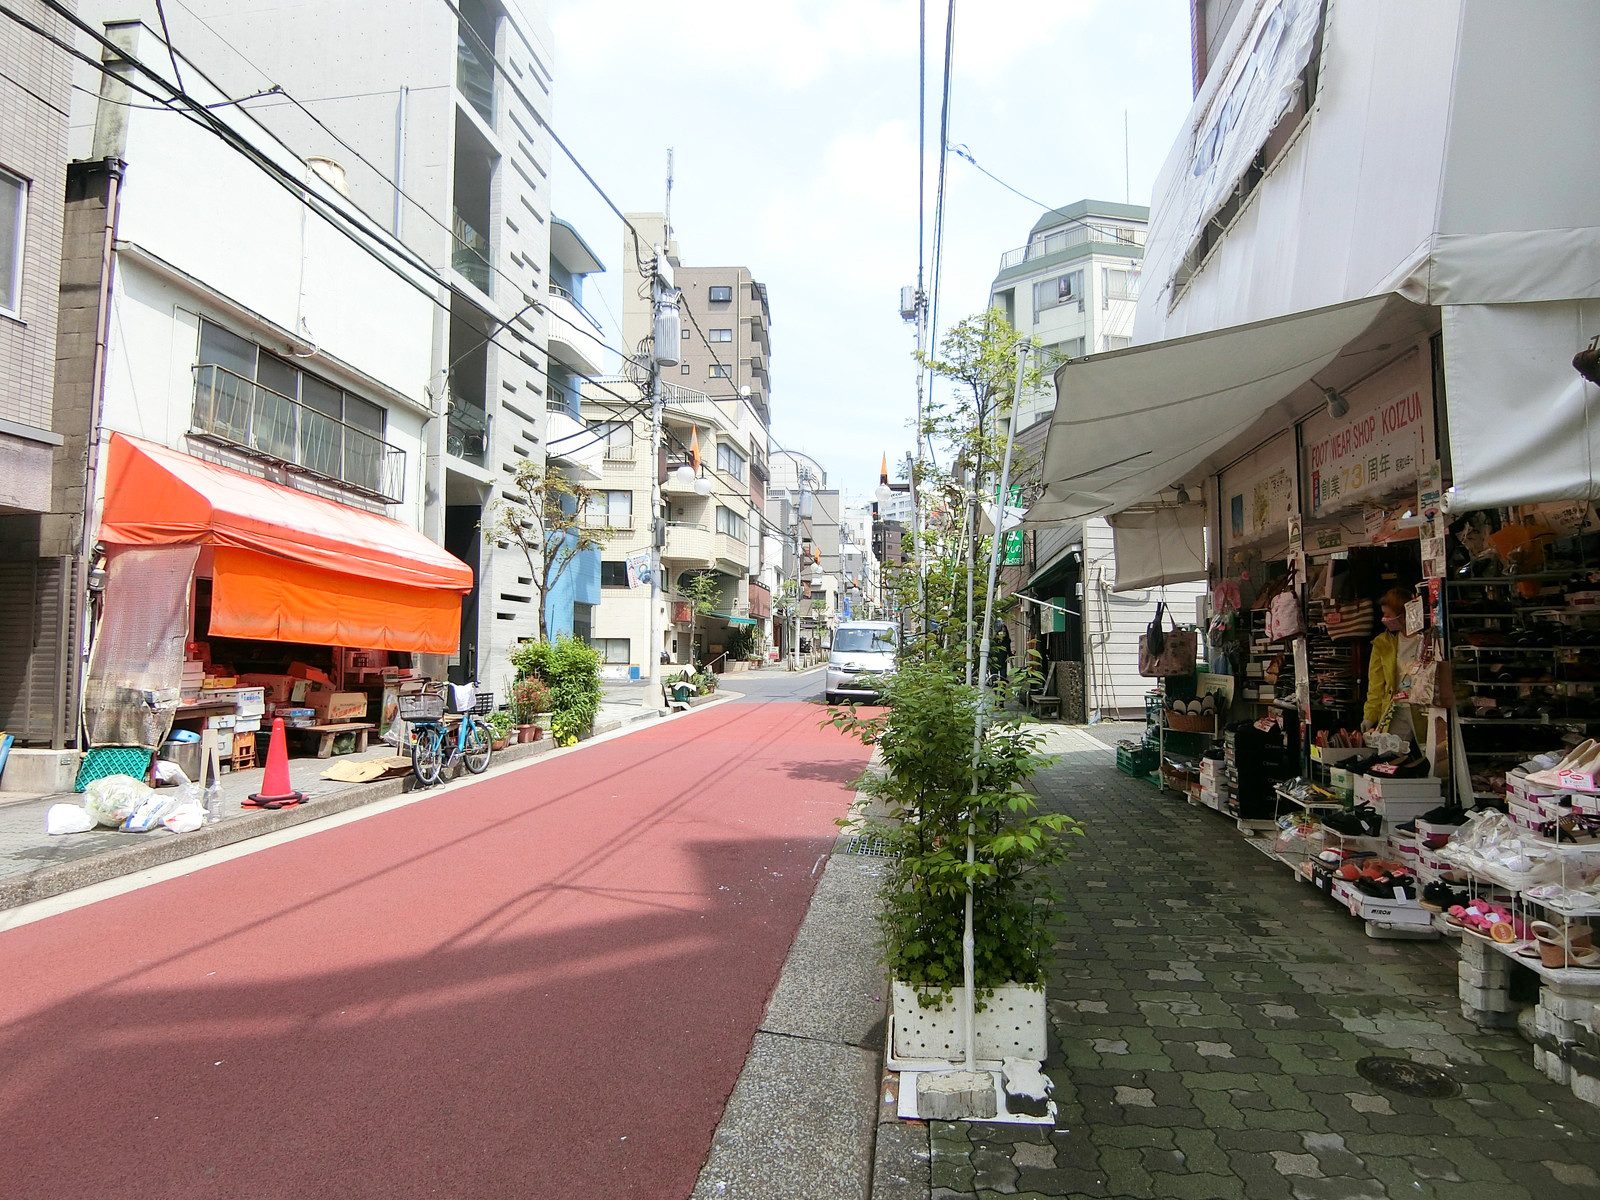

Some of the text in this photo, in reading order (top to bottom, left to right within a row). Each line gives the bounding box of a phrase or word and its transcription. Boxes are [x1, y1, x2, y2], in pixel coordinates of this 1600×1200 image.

[1311, 440, 1328, 469] FOOT
[1330, 430, 1352, 461] WEAR
[1352, 415, 1376, 449] SHOP
